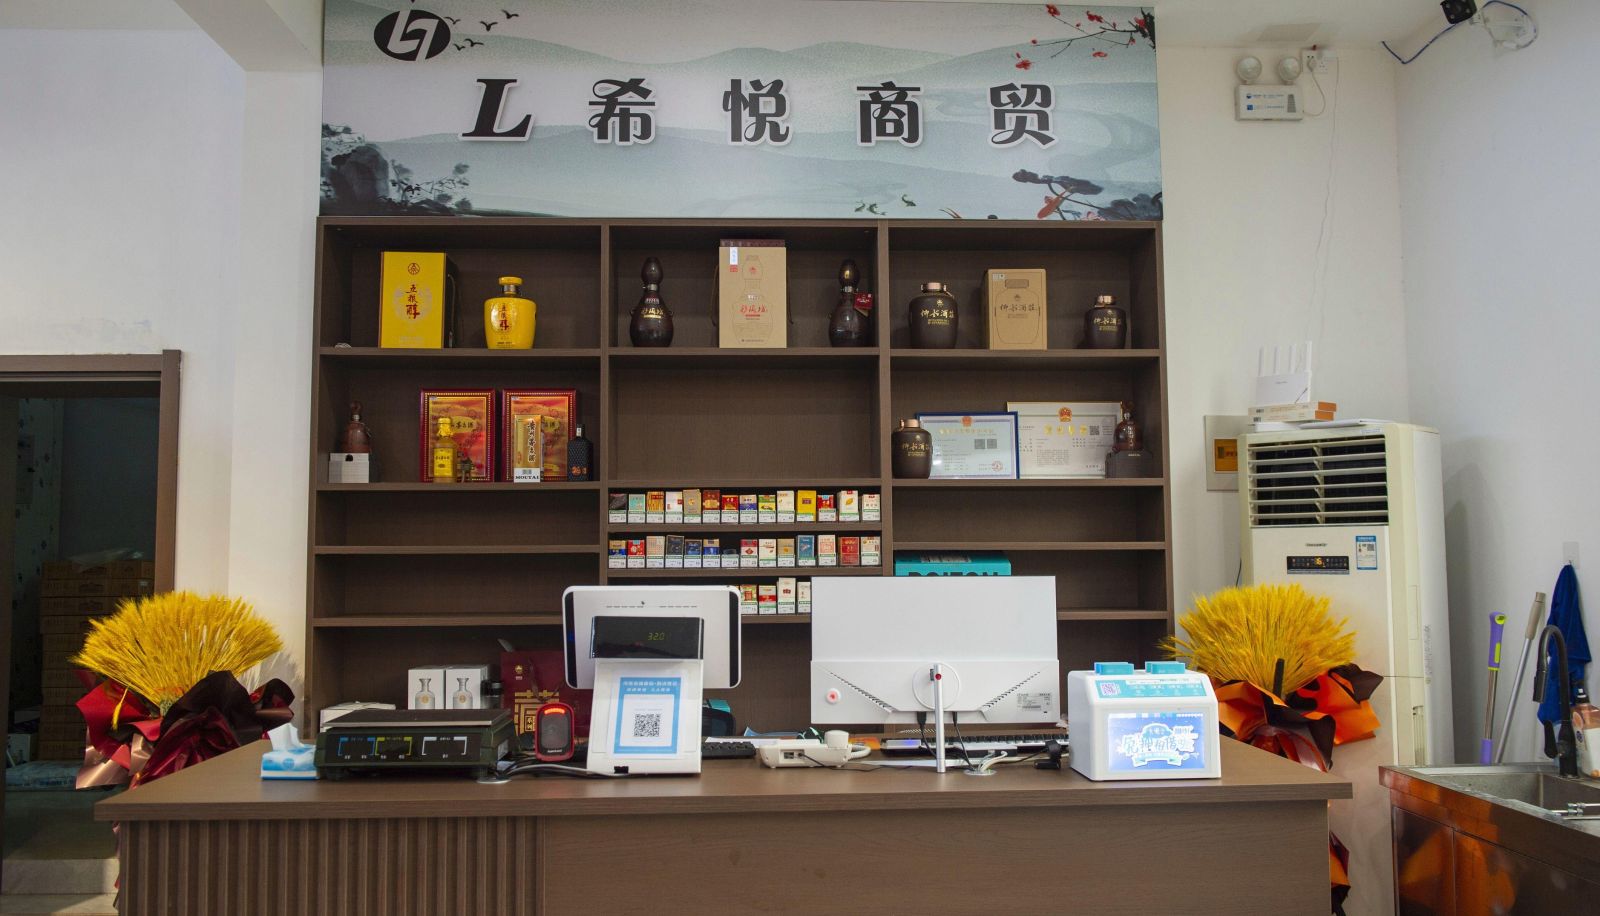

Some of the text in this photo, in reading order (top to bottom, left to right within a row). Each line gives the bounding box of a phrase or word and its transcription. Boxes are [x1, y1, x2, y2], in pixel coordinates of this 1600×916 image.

[461, 78, 533, 138] L
[588, 77, 1057, 147] 希悦商贸
